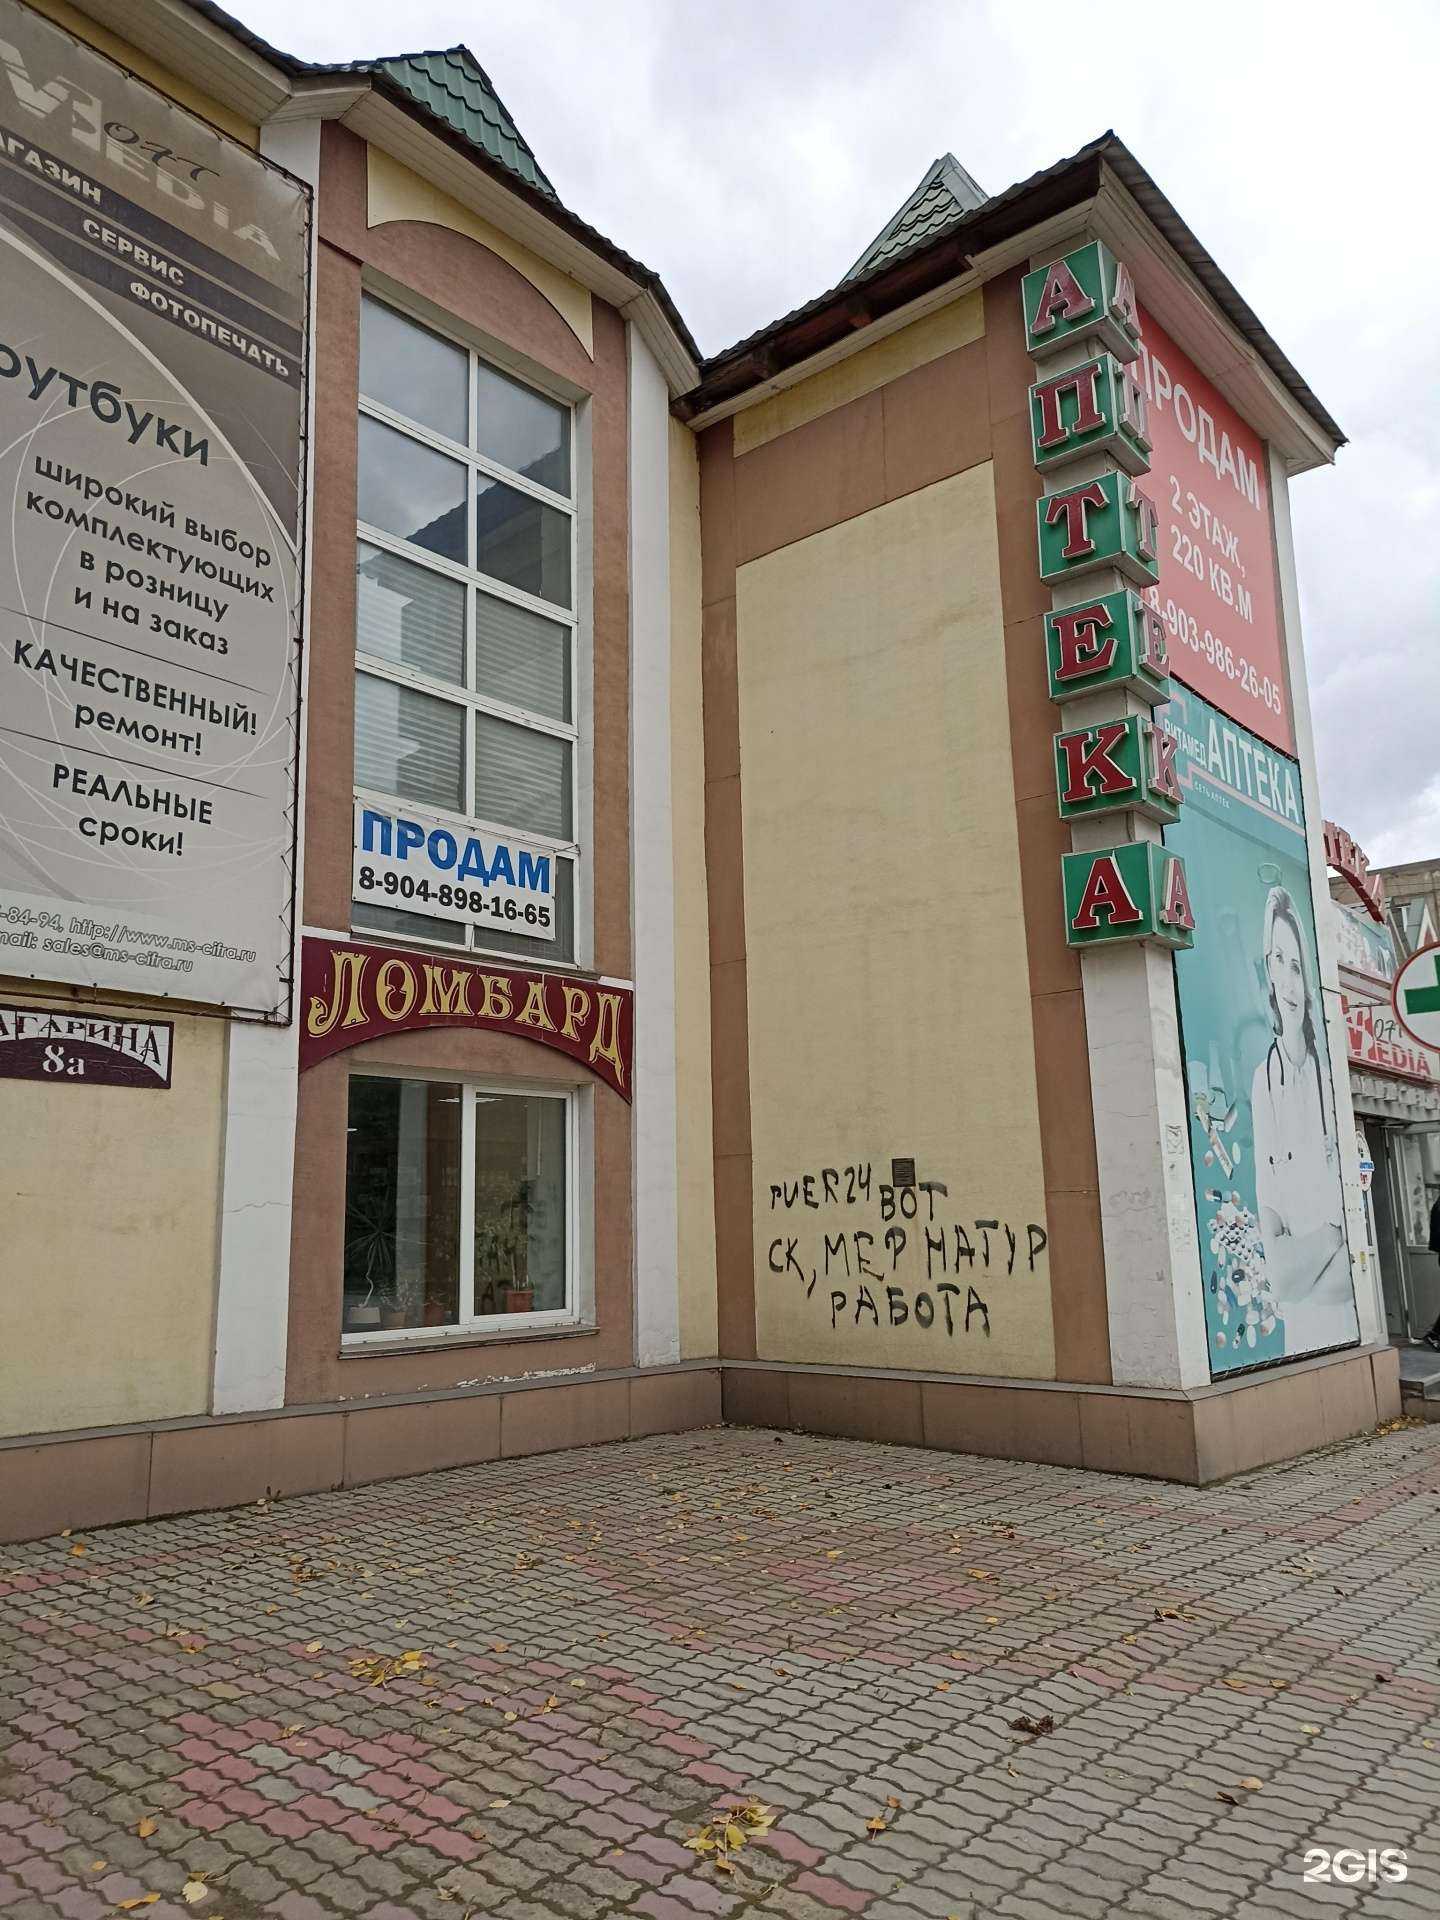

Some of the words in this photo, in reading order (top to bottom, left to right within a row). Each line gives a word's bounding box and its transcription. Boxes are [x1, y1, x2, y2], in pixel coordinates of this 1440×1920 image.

[83, 218, 184, 286] СЕРВИС
[130, 282, 289, 377] ФОТОПЕЧАТЬ
[35, 456, 175, 528] широкий
[184, 517, 271, 567] выбор
[1169, 475, 1183, 515] 2
[1186, 491, 1246, 578] ЭТАЖ,
[26, 491, 274, 603] комплектующих
[1170, 524, 1204, 581] 220
[1208, 557, 1253, 624] КВ.М
[75, 587, 92, 609] и
[102, 597, 140, 625] на
[149, 613, 228, 655] заказ
[80, 550, 94, 571] в
[105, 560, 229, 622] розницу
[13, 639, 257, 736] КАЧЕСТВЕННЫЙ!
[75, 702, 202, 756] ремонт!
[53, 763, 212, 825] РЕАЛЬНЫЕ
[1208, 718, 1299, 824] АПТЕКА
[79, 815, 183, 856] сроки!
[362, 809, 550, 893] ПРОДАМ
[358, 866, 550, 927] 8-904-898-16-65
[42, 937, 193, 972] sales@ms-cifra.ru
[69, 917, 257, 963] http://www.ms-cifra.ru
[307, 948, 626, 1089] ЛОМБАРД
[42, 1045, 85, 1075] 8а
[831, 1283, 990, 1338] РАБОТА
